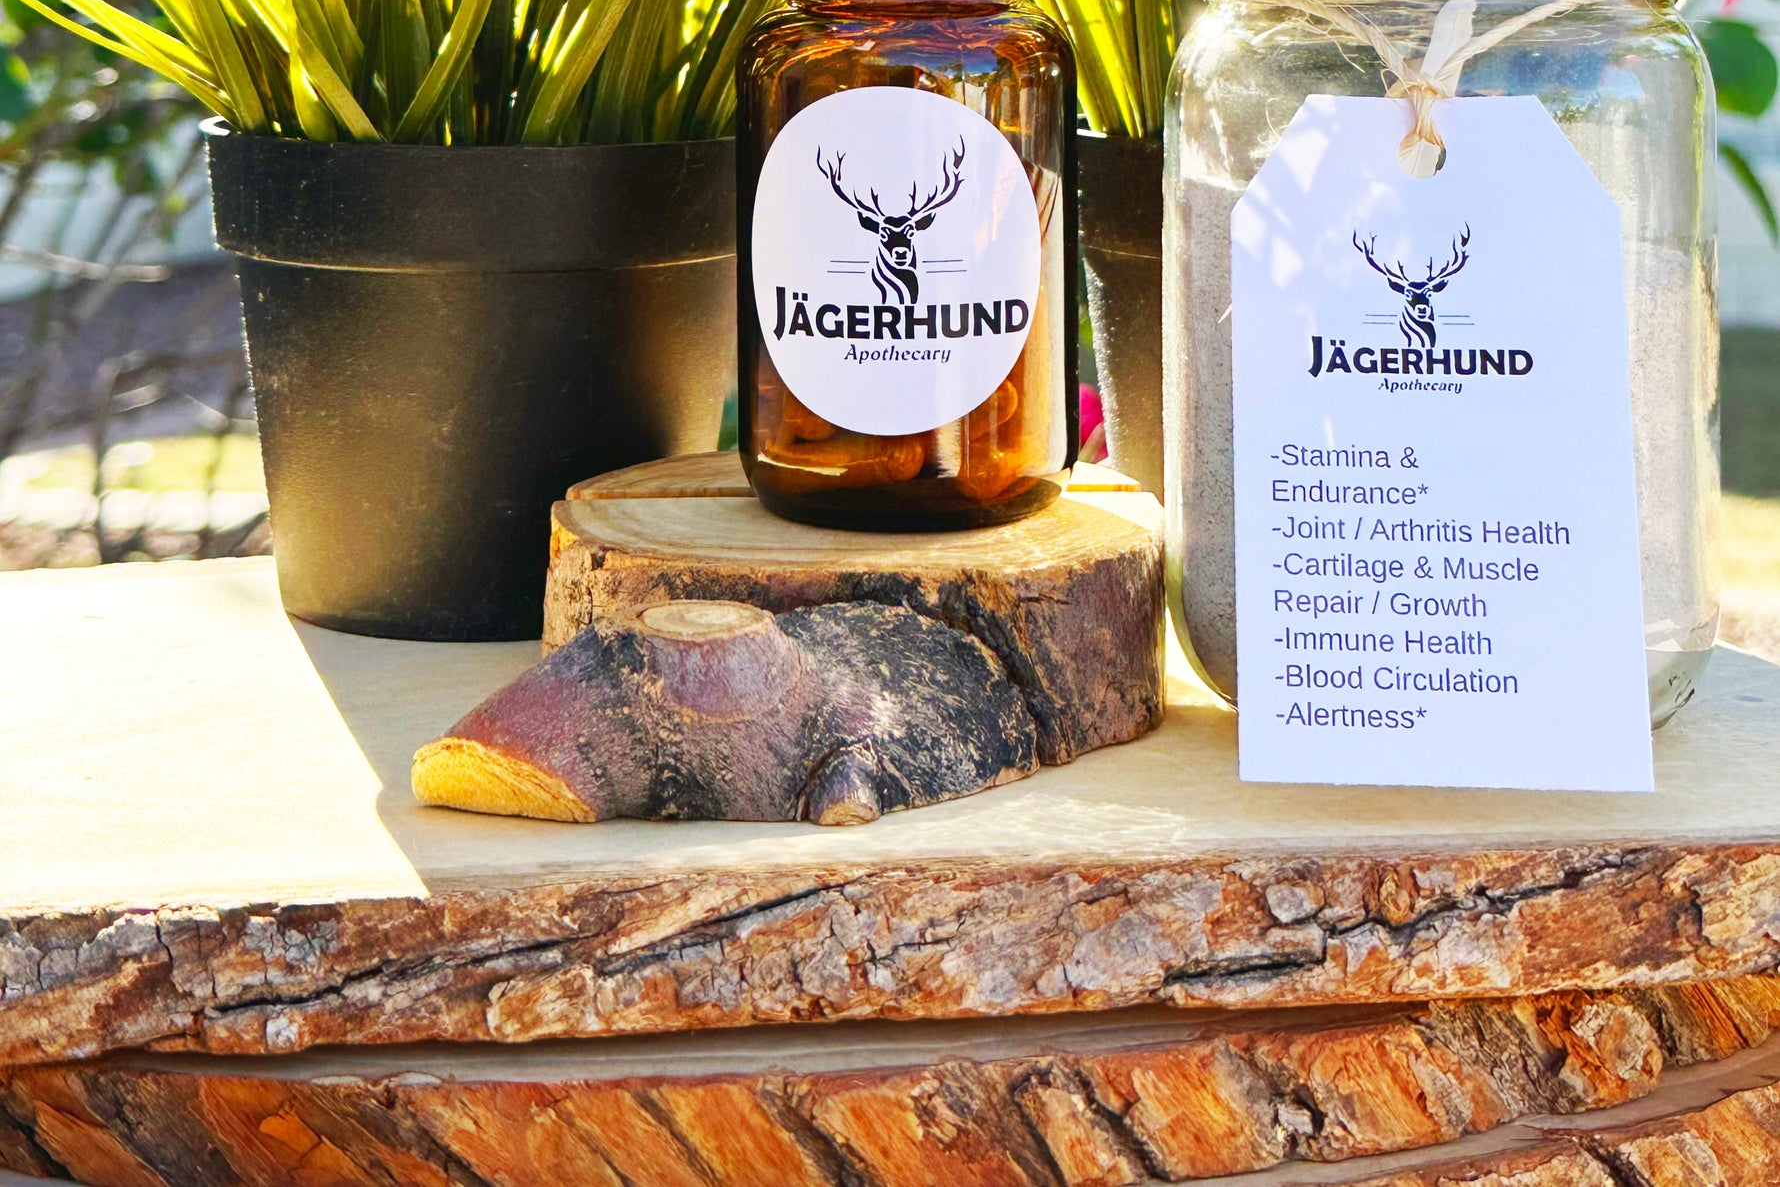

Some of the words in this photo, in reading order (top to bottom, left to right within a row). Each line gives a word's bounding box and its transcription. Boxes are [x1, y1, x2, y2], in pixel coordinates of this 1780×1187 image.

[773, 286, 1029, 340] JÄGERHUND
[844, 344, 951, 364] Apothecary
[1308, 336, 1533, 378] JÄGERHUND
[1378, 378, 1462, 394] Apothecary
[1271, 444, 1391, 468] -Stamina
[1400, 447, 1419, 468] &
[1272, 516, 1346, 539] -Joint
[1354, 517, 1363, 540] /
[1370, 518, 1472, 542] Arthritis
[1483, 521, 1570, 544] Health
[1273, 553, 1404, 583] -Cartilage
[1414, 556, 1434, 579] &
[1444, 557, 1539, 581] Muscle
[1275, 590, 1364, 619] Repair
[1372, 591, 1380, 614] /
[1390, 593, 1487, 617] Growth
[1274, 627, 1394, 652] -Immune
[1405, 630, 1491, 655] Health
[1275, 664, 1362, 689] -Blood
[1374, 666, 1518, 694] Circulation
